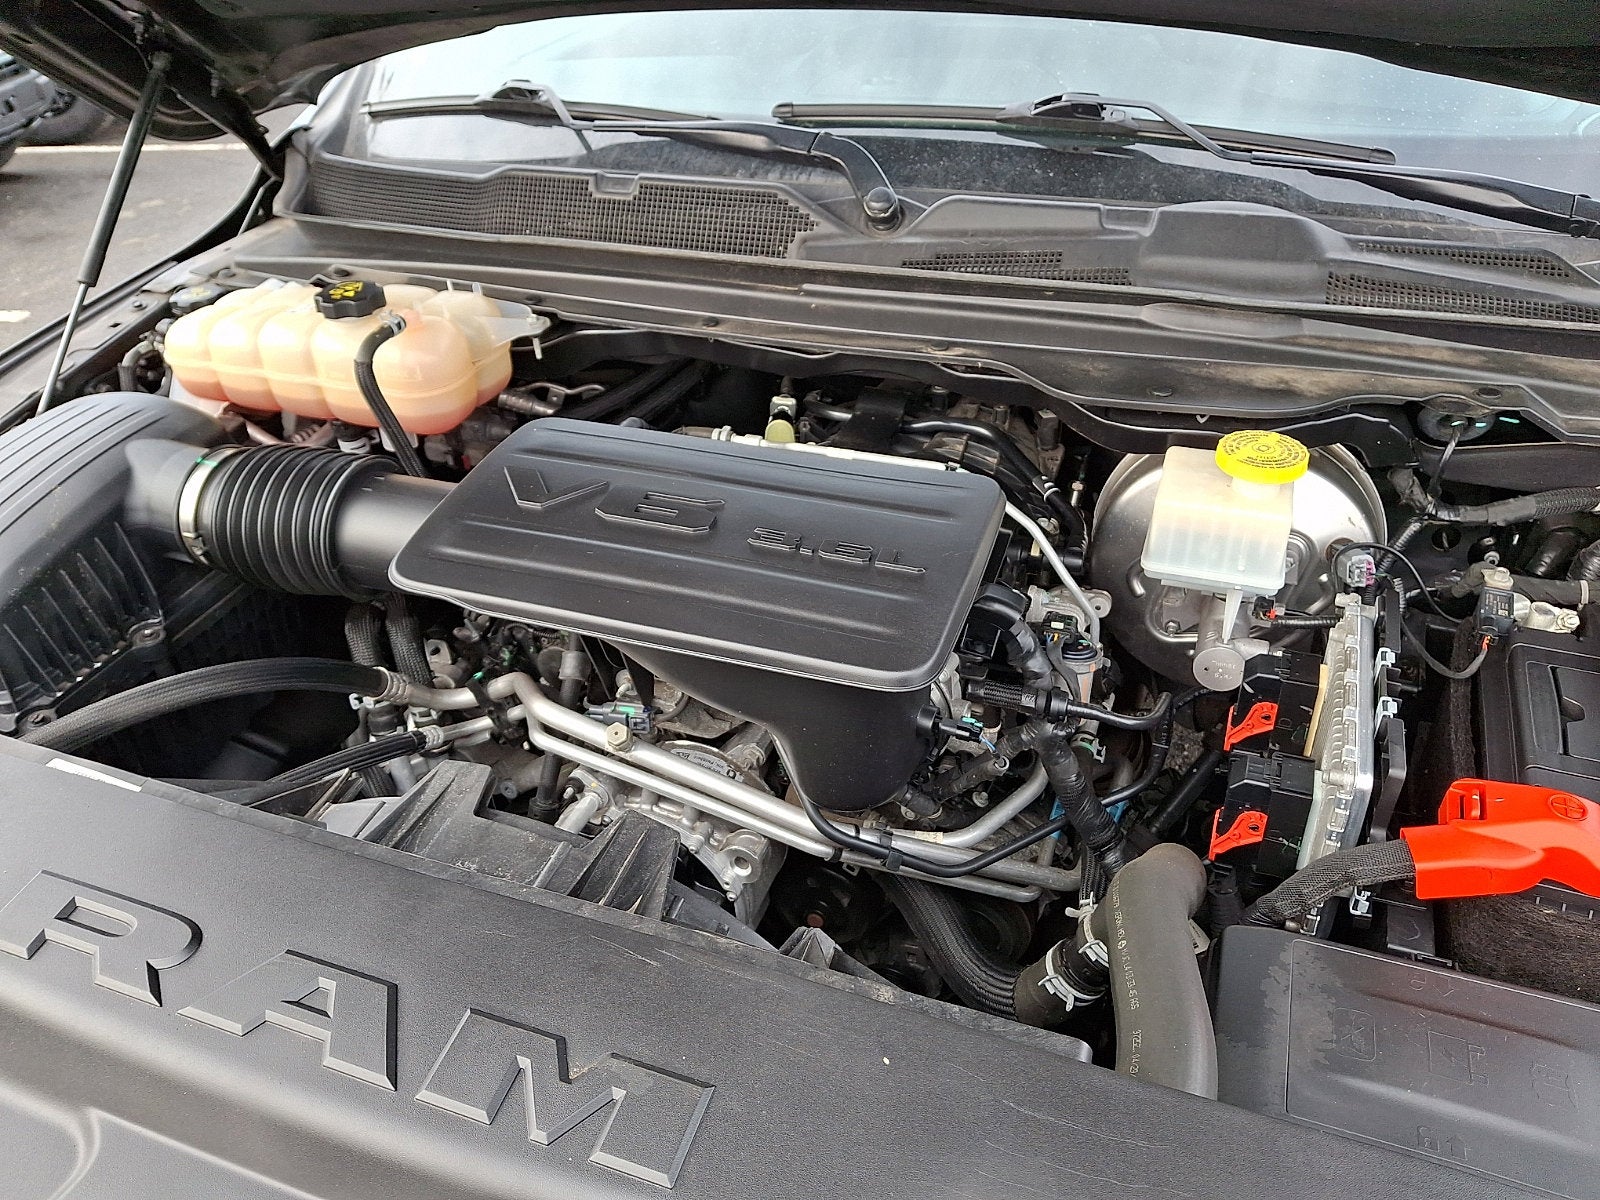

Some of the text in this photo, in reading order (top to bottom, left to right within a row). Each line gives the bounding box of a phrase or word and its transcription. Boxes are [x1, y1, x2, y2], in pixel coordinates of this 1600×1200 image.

[503, 465, 927, 575] V6 3.6L
[0, 870, 715, 1189] RAM
